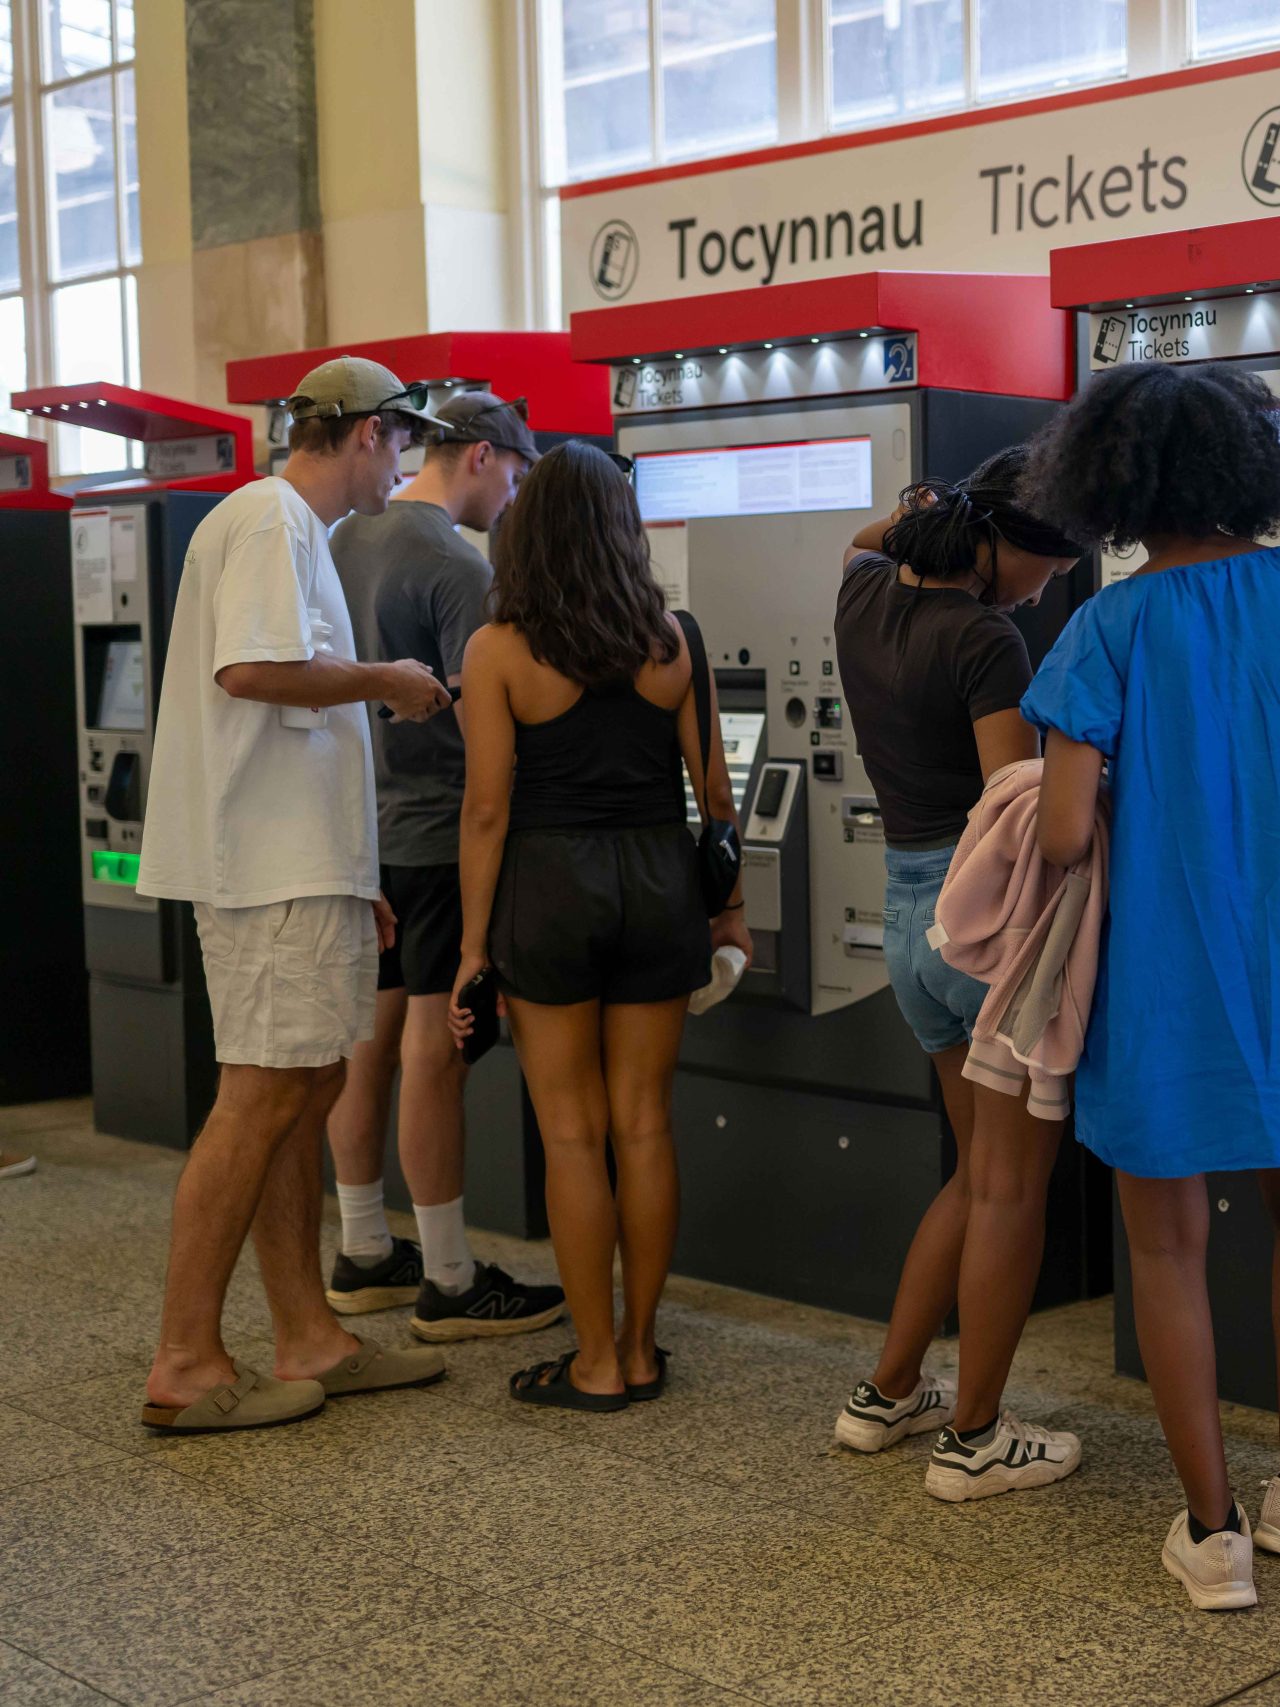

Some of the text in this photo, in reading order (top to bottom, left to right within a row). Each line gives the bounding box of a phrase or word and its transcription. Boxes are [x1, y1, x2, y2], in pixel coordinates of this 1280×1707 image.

[668, 146, 1188, 285] Tocynnau Tickets
[1127, 306, 1217, 334] Tocynnau
[1127, 336, 1190, 361] Tickets
